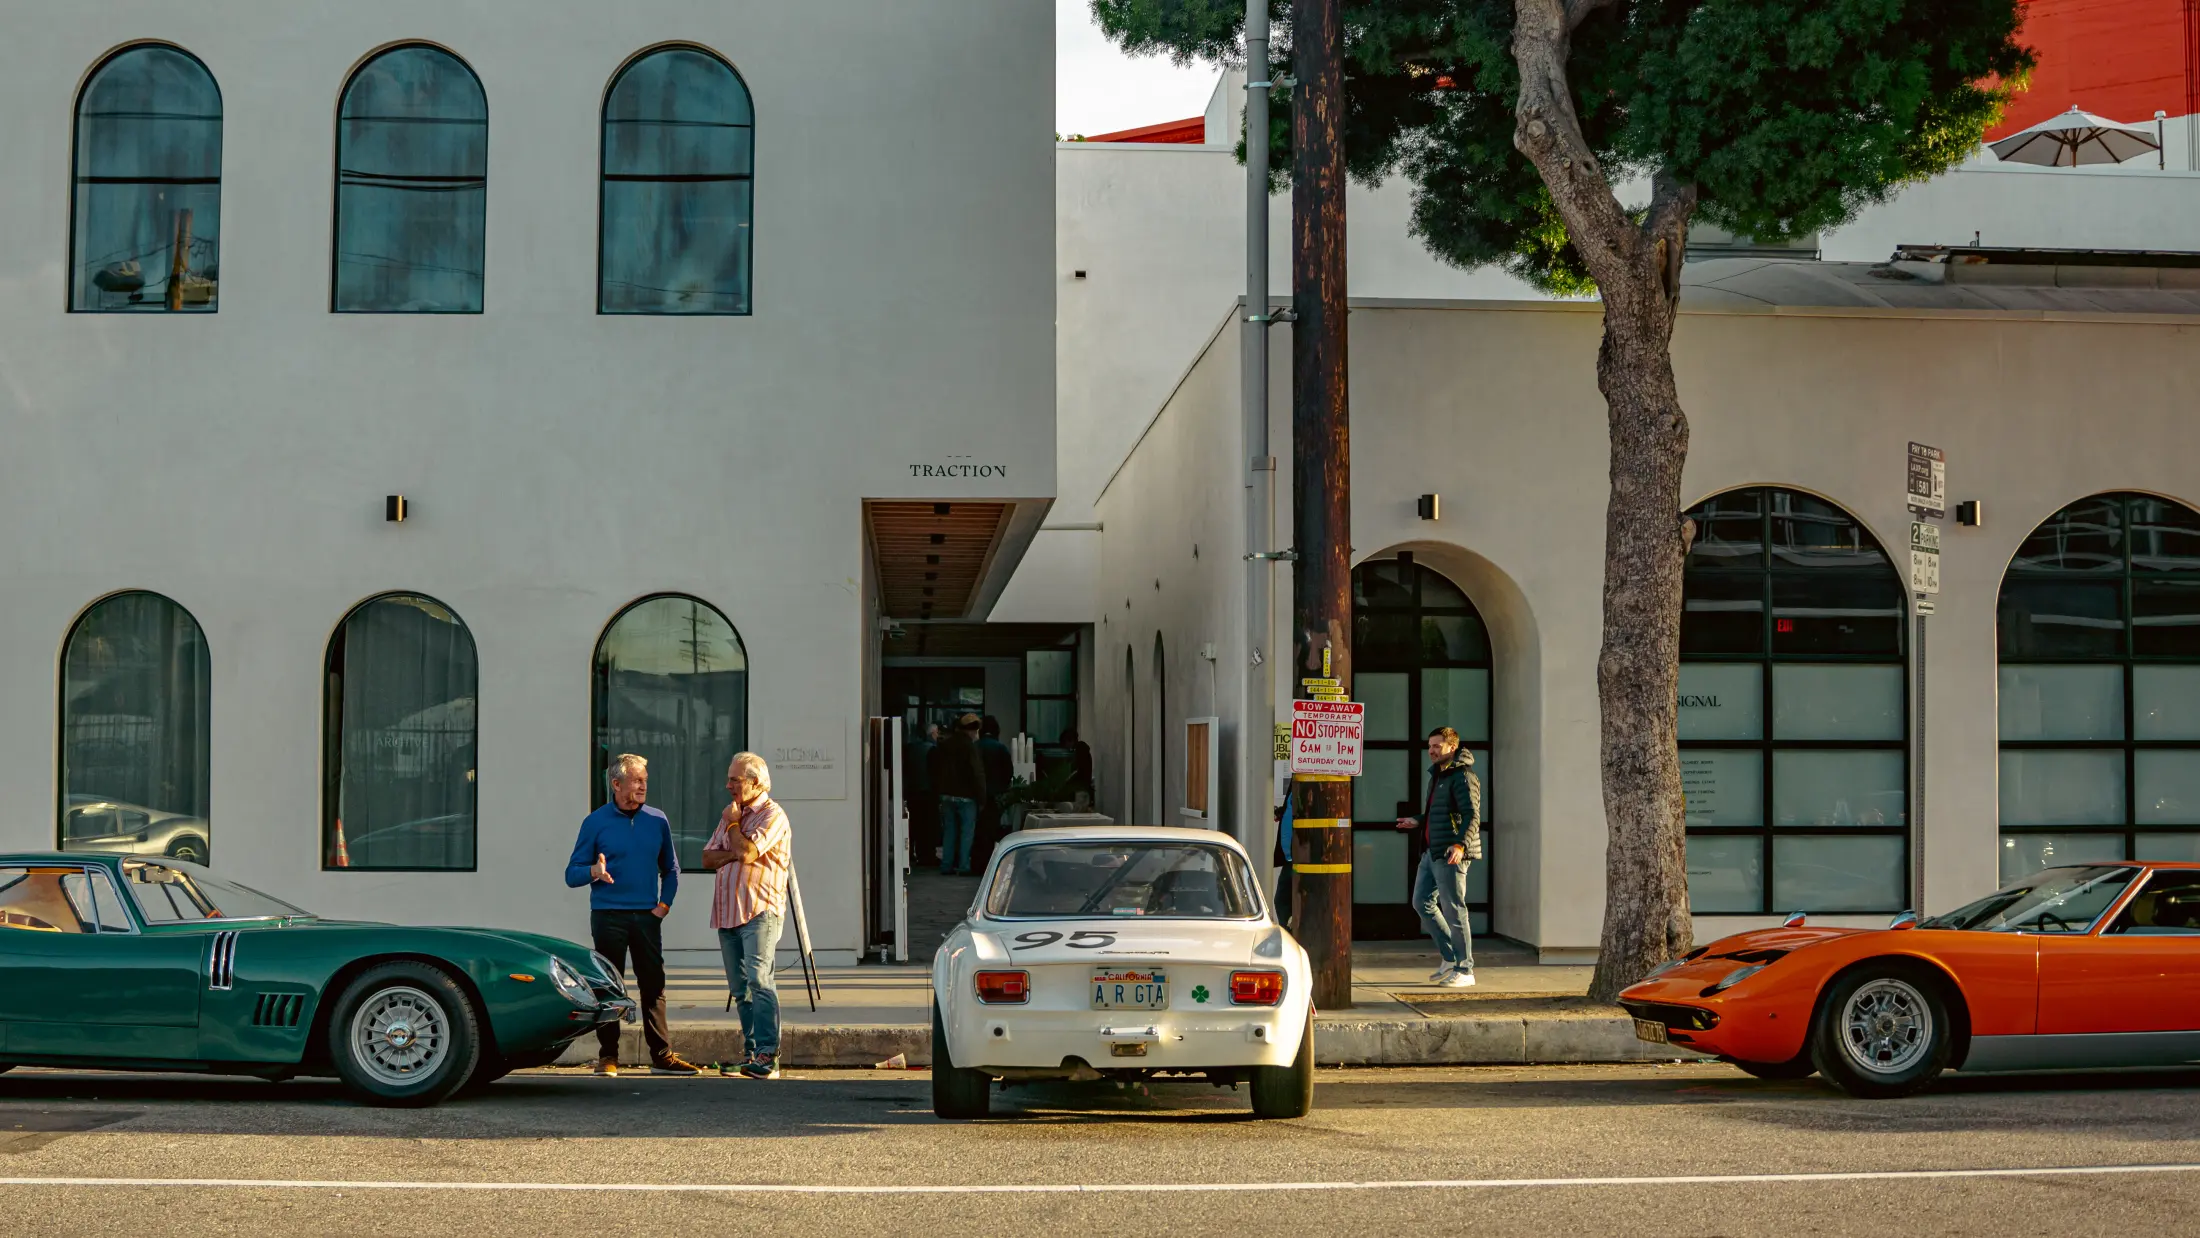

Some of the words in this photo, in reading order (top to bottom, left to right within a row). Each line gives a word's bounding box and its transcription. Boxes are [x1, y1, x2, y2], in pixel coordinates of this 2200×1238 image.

[1911, 444, 1920, 455] PAY
[1921, 446, 1927, 457] TO
[1927, 448, 1941, 460] PARK
[909, 464, 1006, 477] TRACTION
[1912, 524, 1919, 543] 2
[1920, 533, 1939, 548] PARKING
[1301, 702, 1356, 713] TOW-AWAY
[1303, 712, 1353, 721] TEMPORARY
[1295, 720, 1316, 738] NO
[1318, 724, 1360, 739] STOPPING
[1274, 733, 1291, 744] TIC
[1300, 740, 1321, 753] 6AM
[1337, 741, 1354, 755] 1PM
[1297, 757, 1334, 765] SATURDAY
[1337, 758, 1356, 766] ONLY
[1012, 930, 1118, 951] 95
[1108, 973, 1152, 981] CALIFORNIA
[1095, 984, 1104, 1004] A
[1115, 984, 1124, 1004] R
[1135, 984, 1164, 1004] GTA
